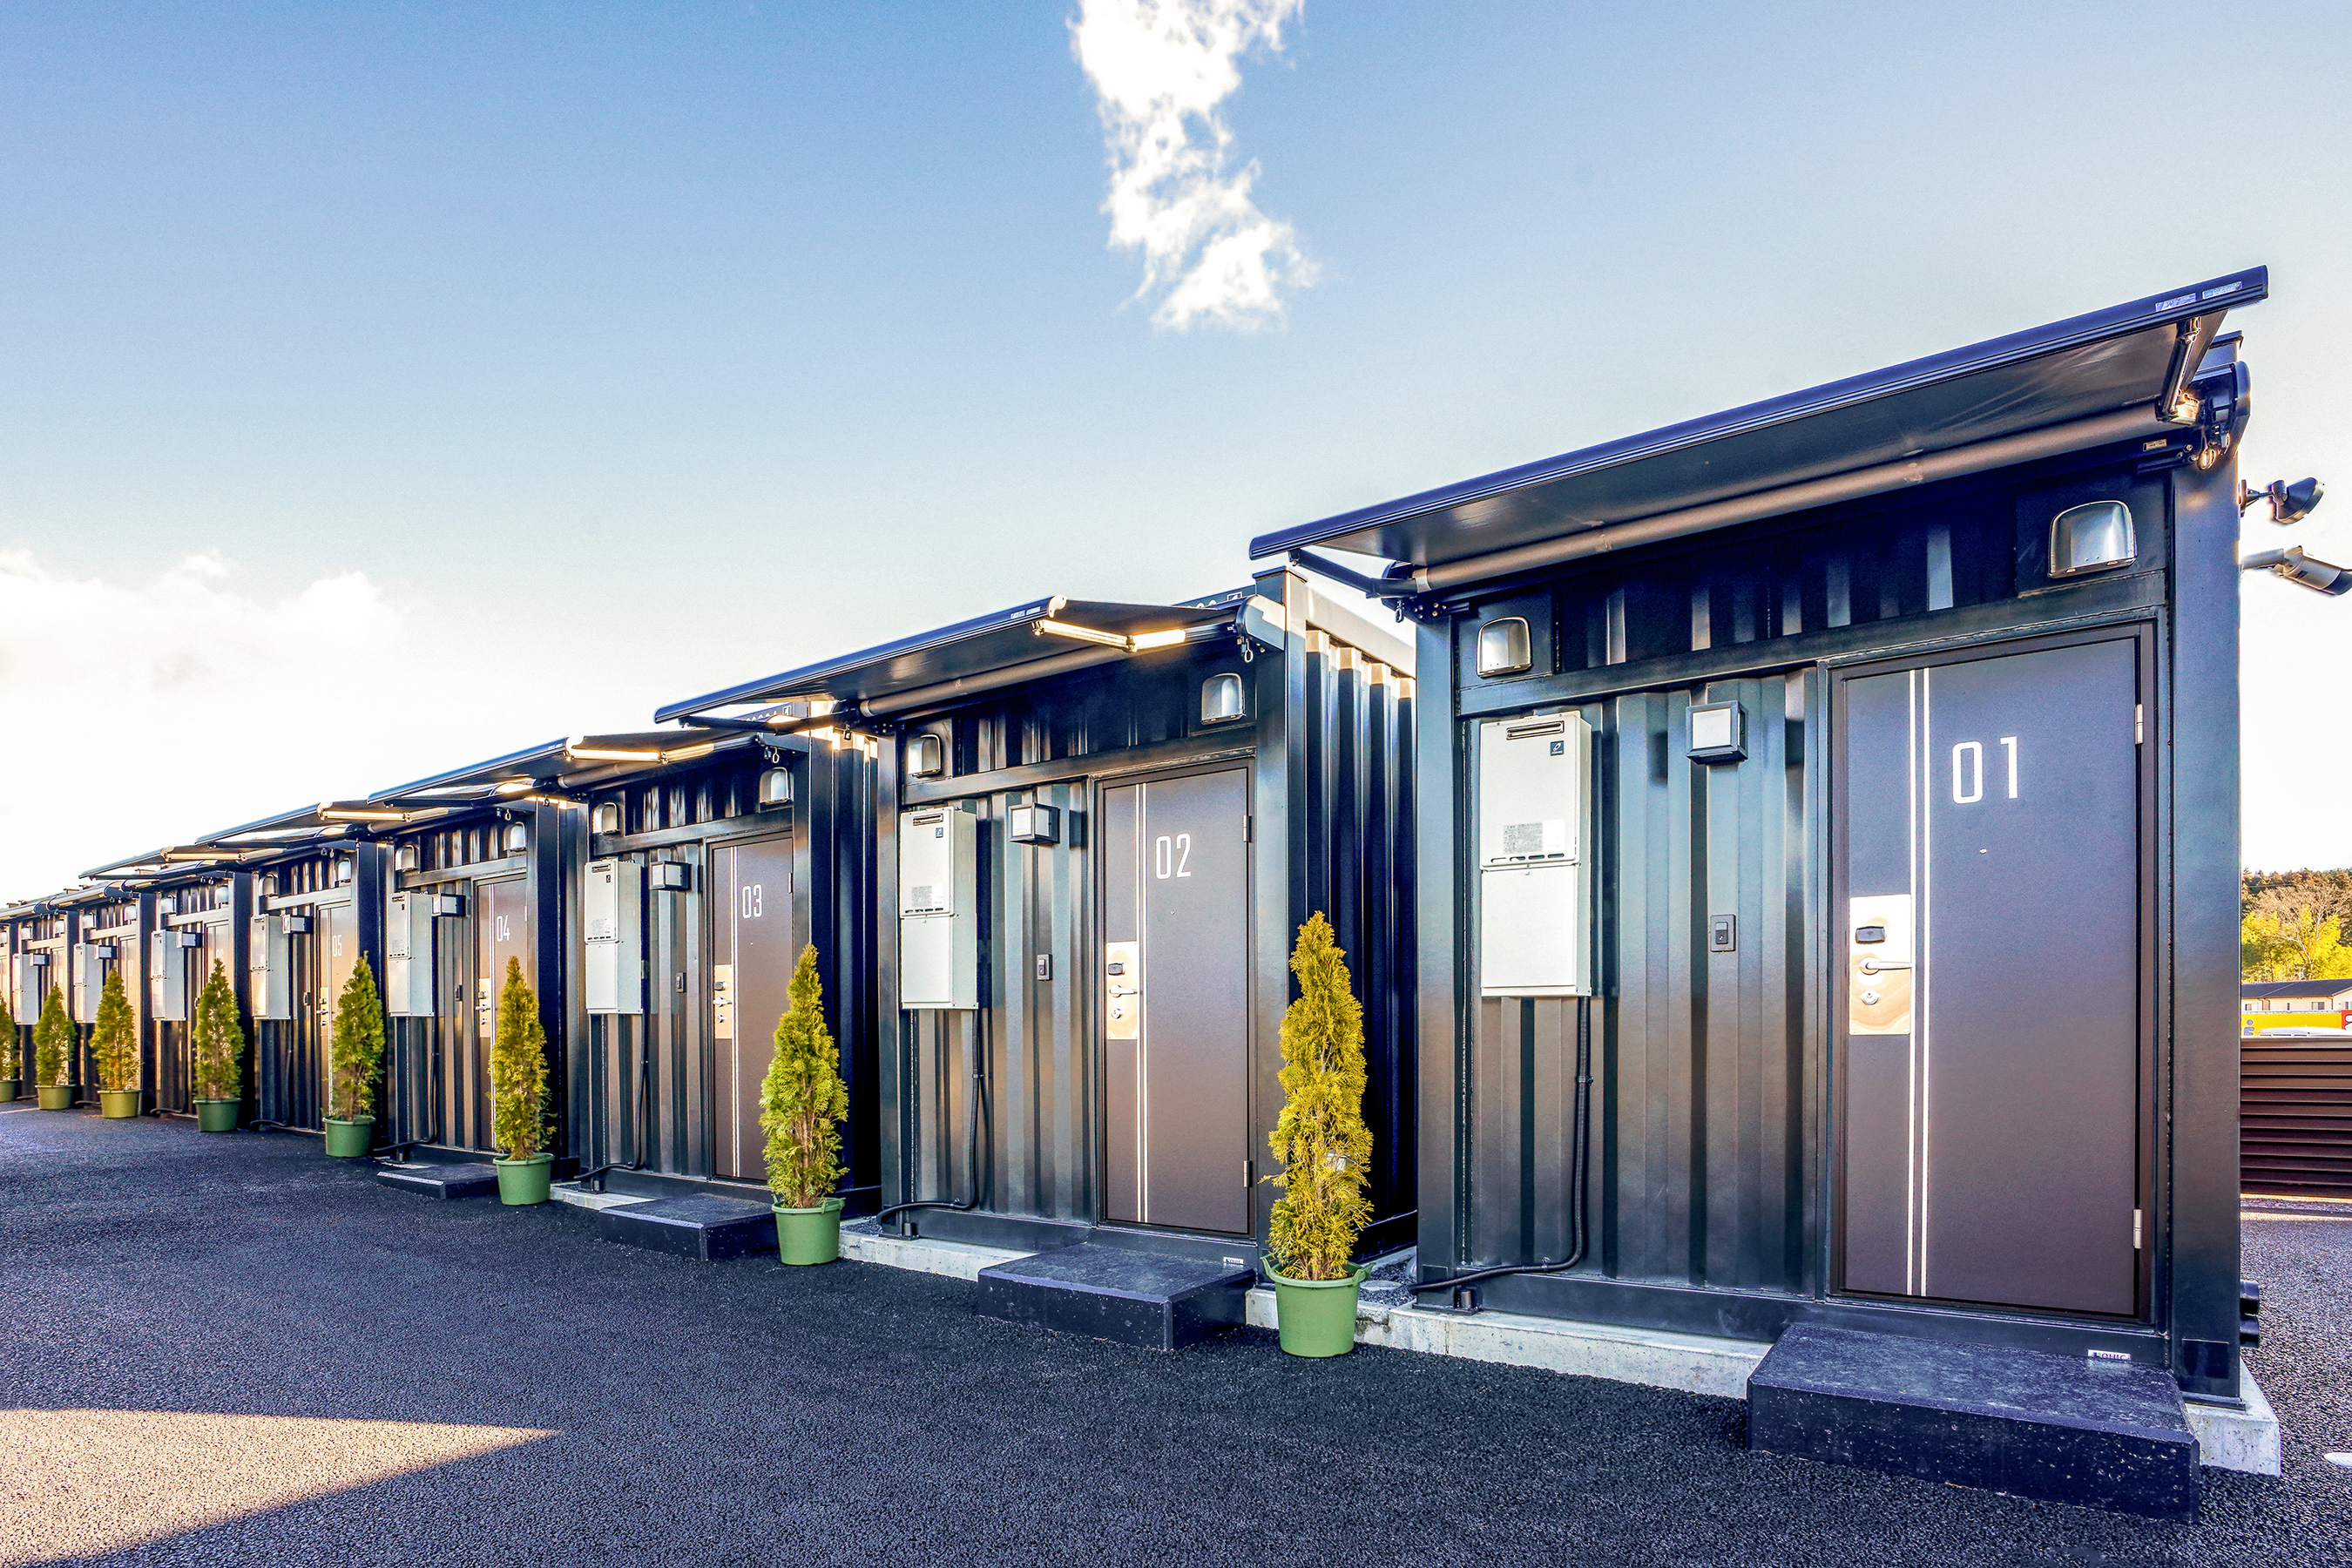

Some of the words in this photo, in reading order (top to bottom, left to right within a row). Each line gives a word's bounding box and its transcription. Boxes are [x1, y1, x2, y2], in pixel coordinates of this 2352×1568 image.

[1952, 736, 2019, 804] 01
[1155, 833, 1193, 880] 02
[741, 883, 763, 919] 03
[333, 935, 342, 956] 05
[497, 915, 510, 942] 04
